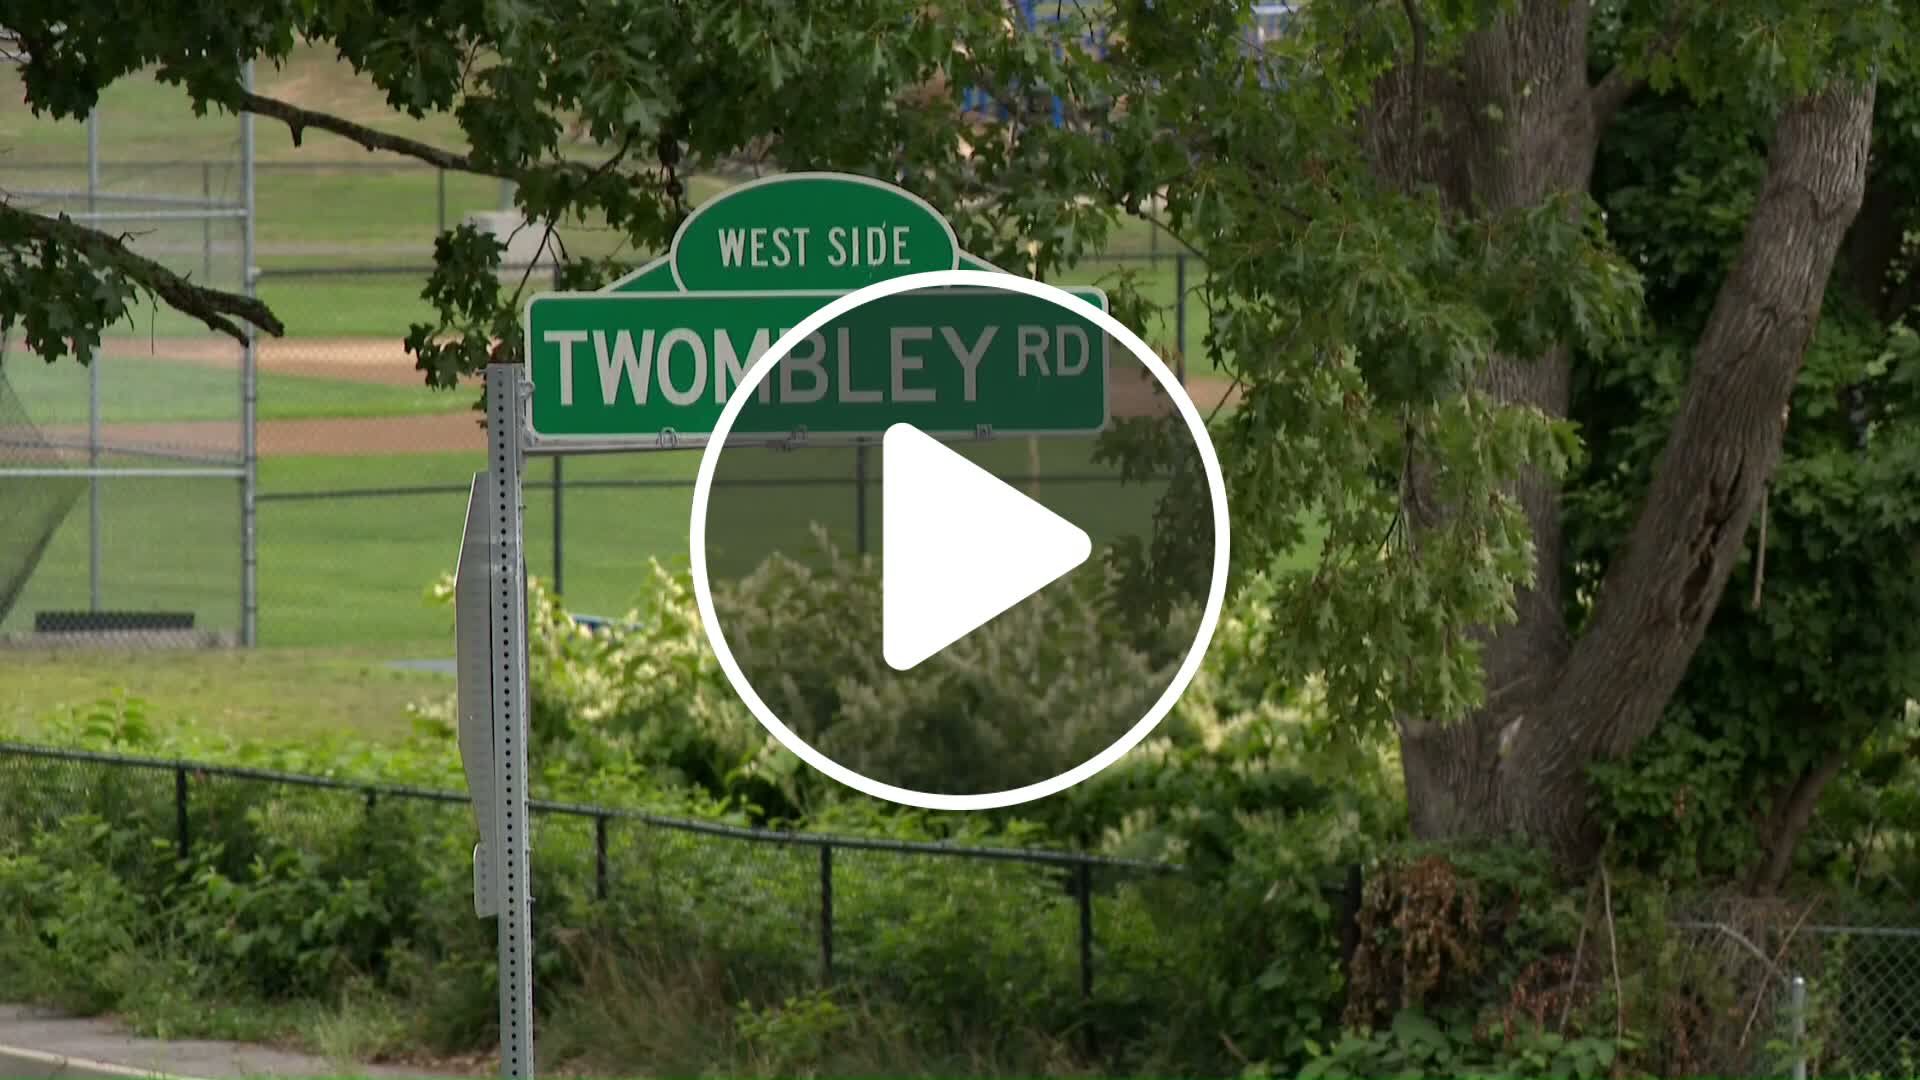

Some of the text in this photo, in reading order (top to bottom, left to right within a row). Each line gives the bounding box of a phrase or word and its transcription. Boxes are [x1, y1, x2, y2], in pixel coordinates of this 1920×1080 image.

[718, 226, 911, 267] WEST SIDE
[543, 326, 1090, 406] TWOMBLEY RD
